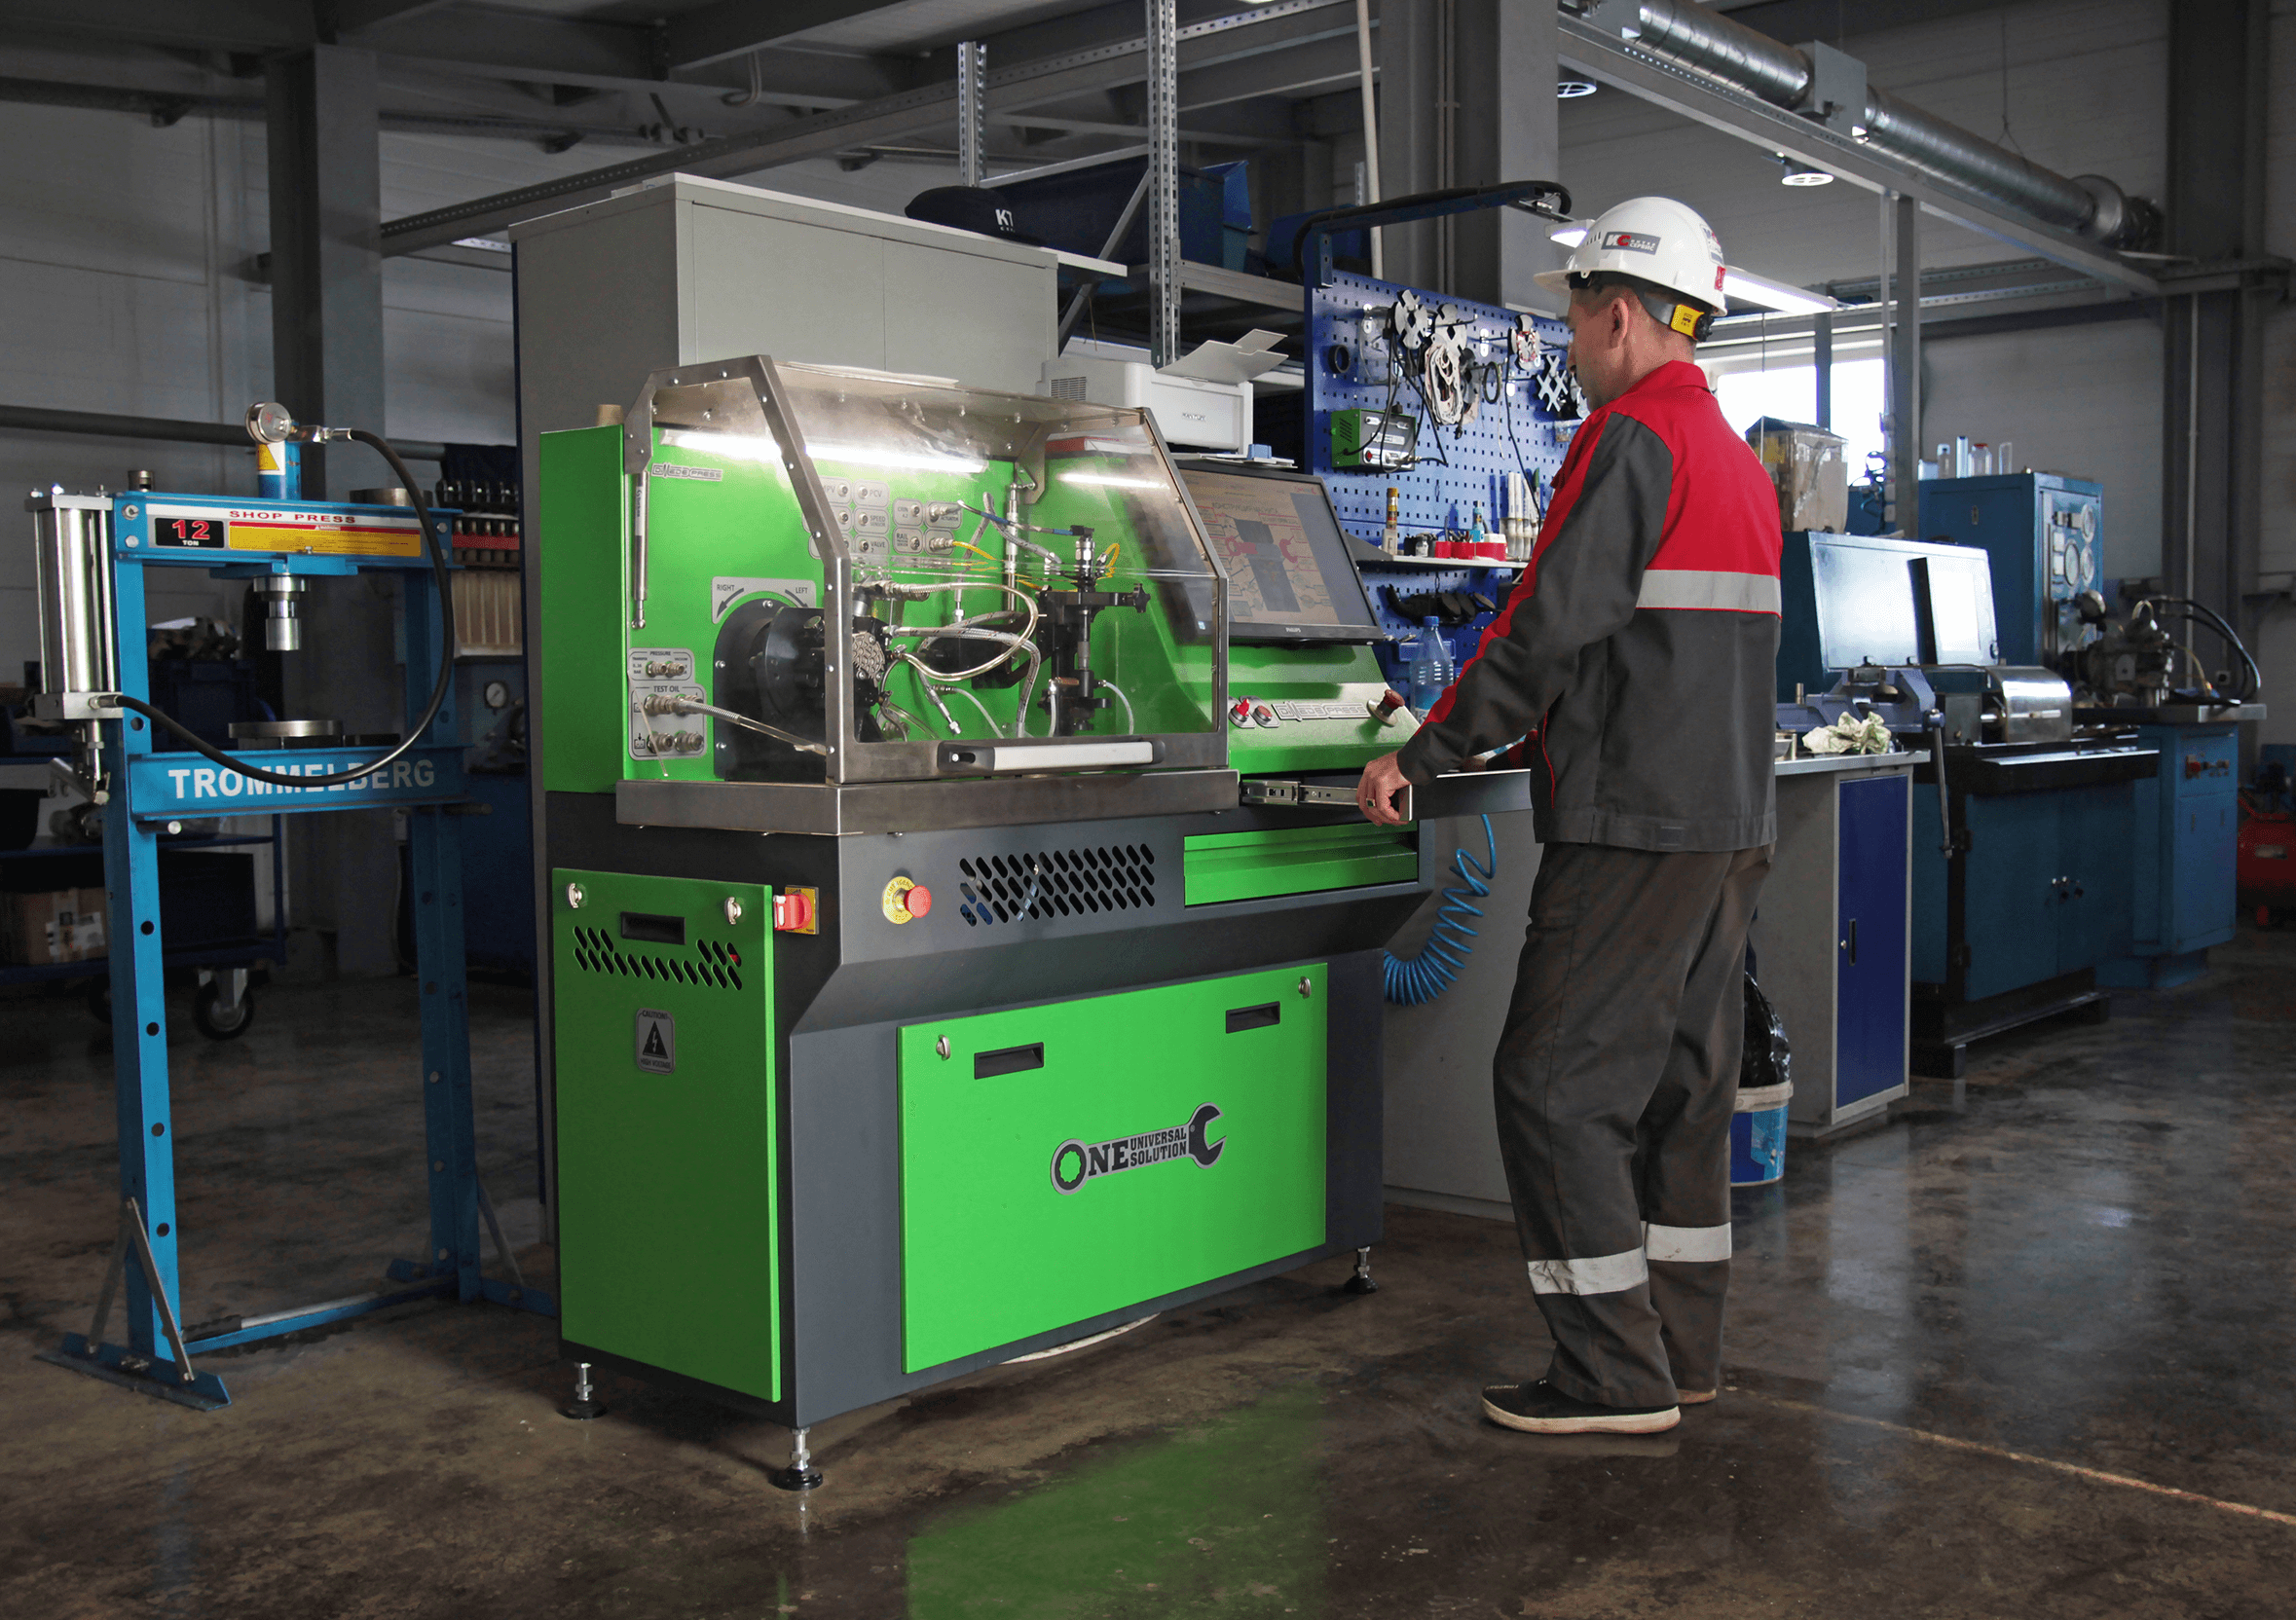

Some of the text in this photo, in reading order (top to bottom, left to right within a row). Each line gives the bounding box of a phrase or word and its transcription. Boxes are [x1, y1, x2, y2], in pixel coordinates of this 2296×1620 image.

[870, 489, 882, 497] PCV
[230, 510, 356, 524] SHOP PRESS
[171, 520, 210, 539] 12
[167, 759, 435, 799] TROMMELBERG
[652, 1060, 671, 1069] VOLTAGE
[1130, 1126, 1187, 1151] UNIVERSAL
[1055, 1139, 1129, 1191] ONE
[1130, 1141, 1187, 1167] SOLUTION
